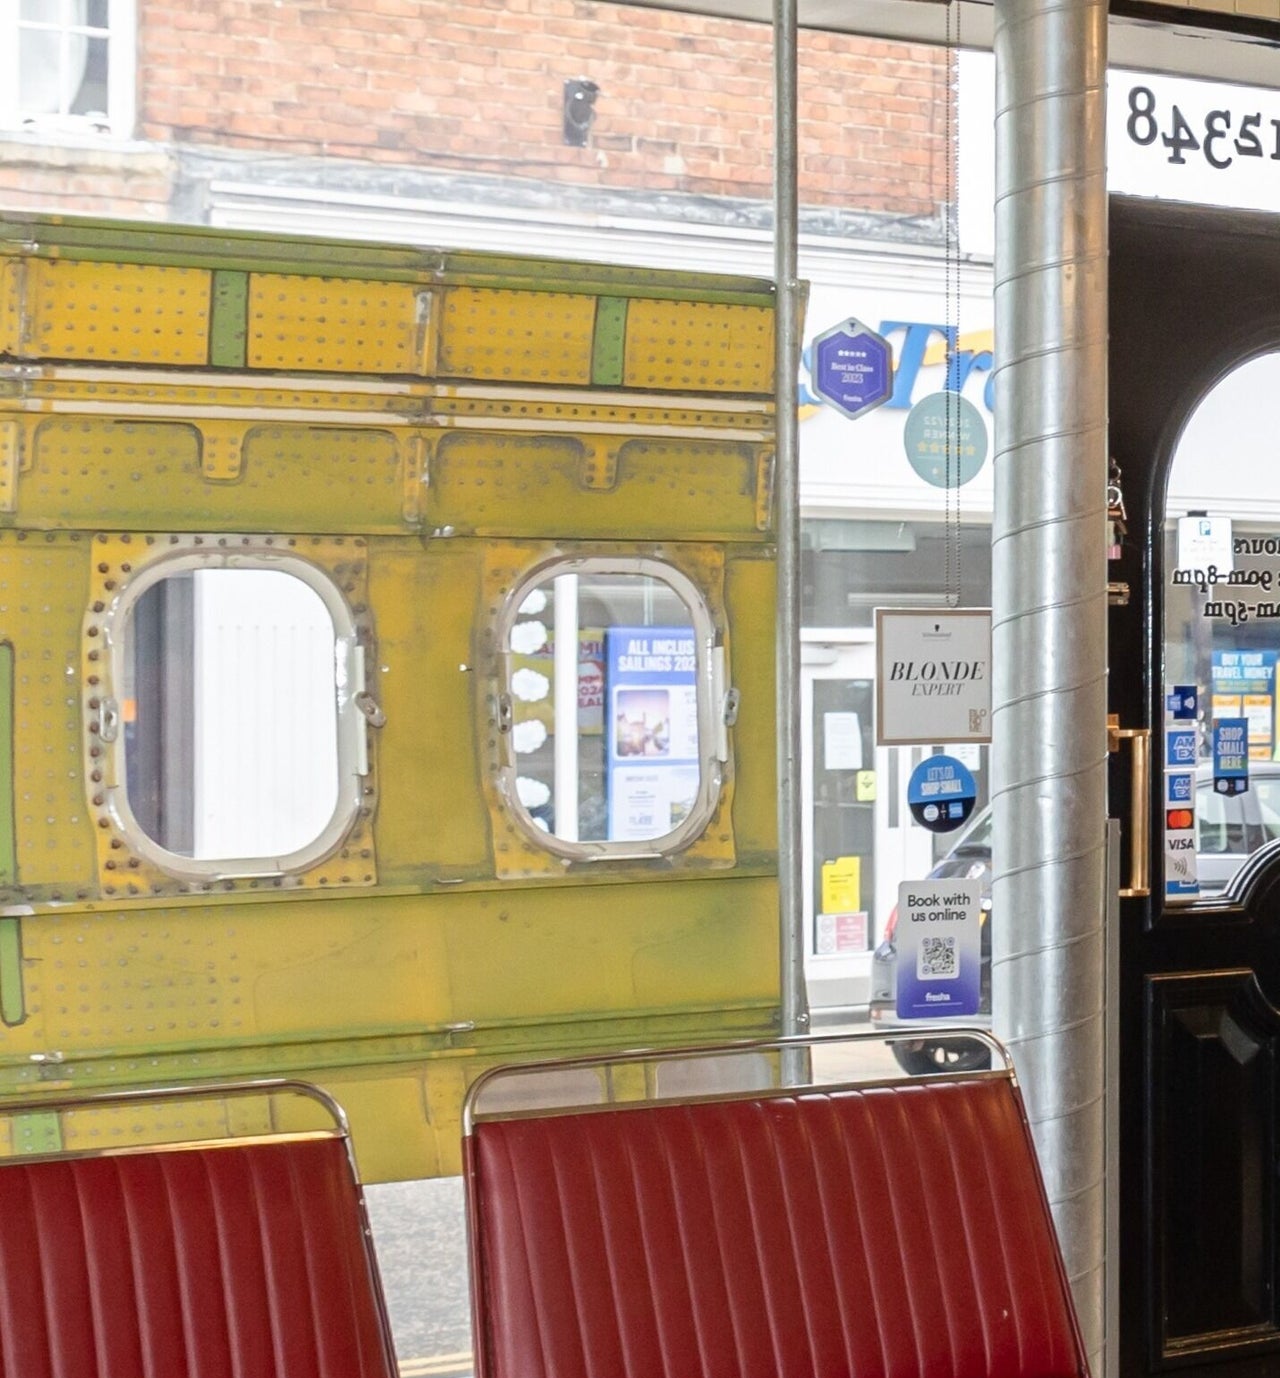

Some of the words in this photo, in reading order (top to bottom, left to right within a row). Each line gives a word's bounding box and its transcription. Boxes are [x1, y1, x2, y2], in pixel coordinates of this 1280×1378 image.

[627, 639, 650, 655] ALL
[618, 655, 672, 672] SAILINGS
[890, 661, 986, 681] BLONDE
[1212, 666, 1242, 679] TRAVEL
[1243, 666, 1273, 679] MONEY
[912, 683, 966, 696] EXPERT
[1219, 727, 1244, 741] SHOP
[1173, 736, 1196, 750] AM
[1217, 741, 1246, 755] SMALL
[1176, 748, 1196, 759] EX
[1219, 756, 1243, 770] HERE
[1173, 778, 1191, 788] AM
[1175, 788, 1191, 798] EX
[1168, 838, 1195, 850] VISA
[907, 893, 940, 907] Book
[942, 892, 971, 906] with
[911, 912, 926, 922] us
[928, 908, 967, 921] online
